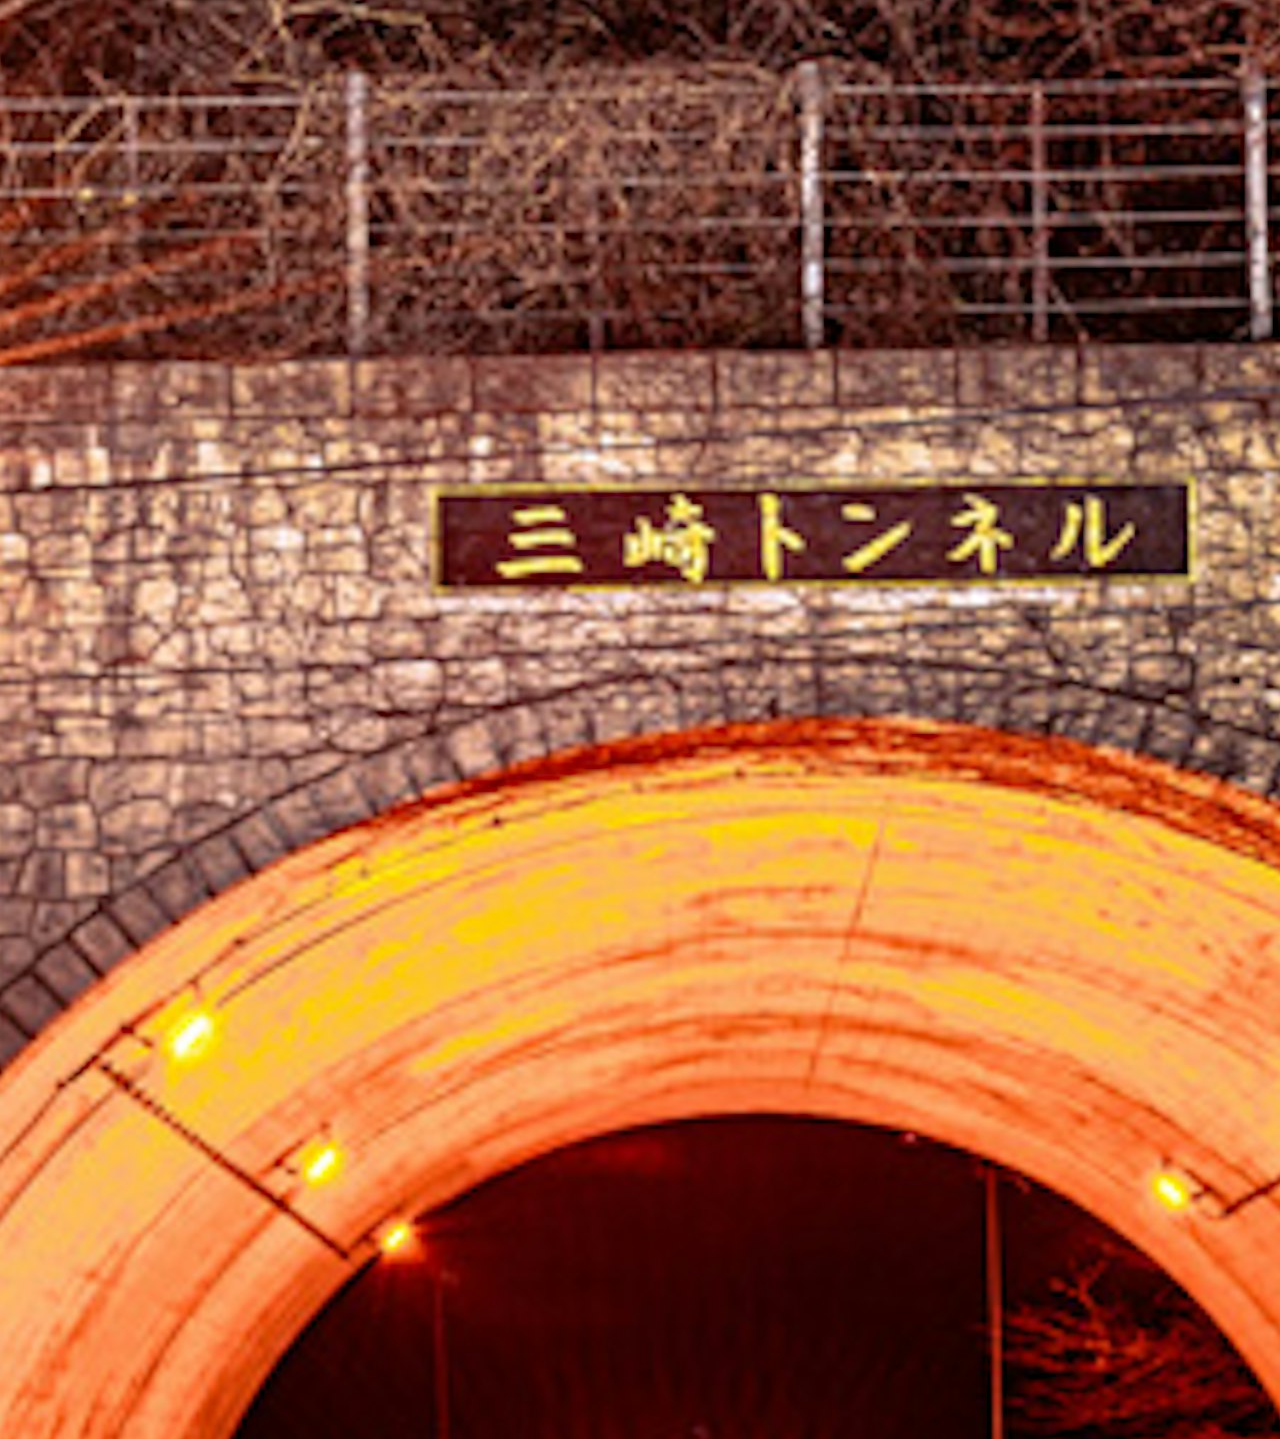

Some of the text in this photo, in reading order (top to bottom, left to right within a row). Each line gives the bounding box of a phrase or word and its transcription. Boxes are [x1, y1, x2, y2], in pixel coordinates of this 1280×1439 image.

[495, 493, 1135, 582] 三崎トンネル
